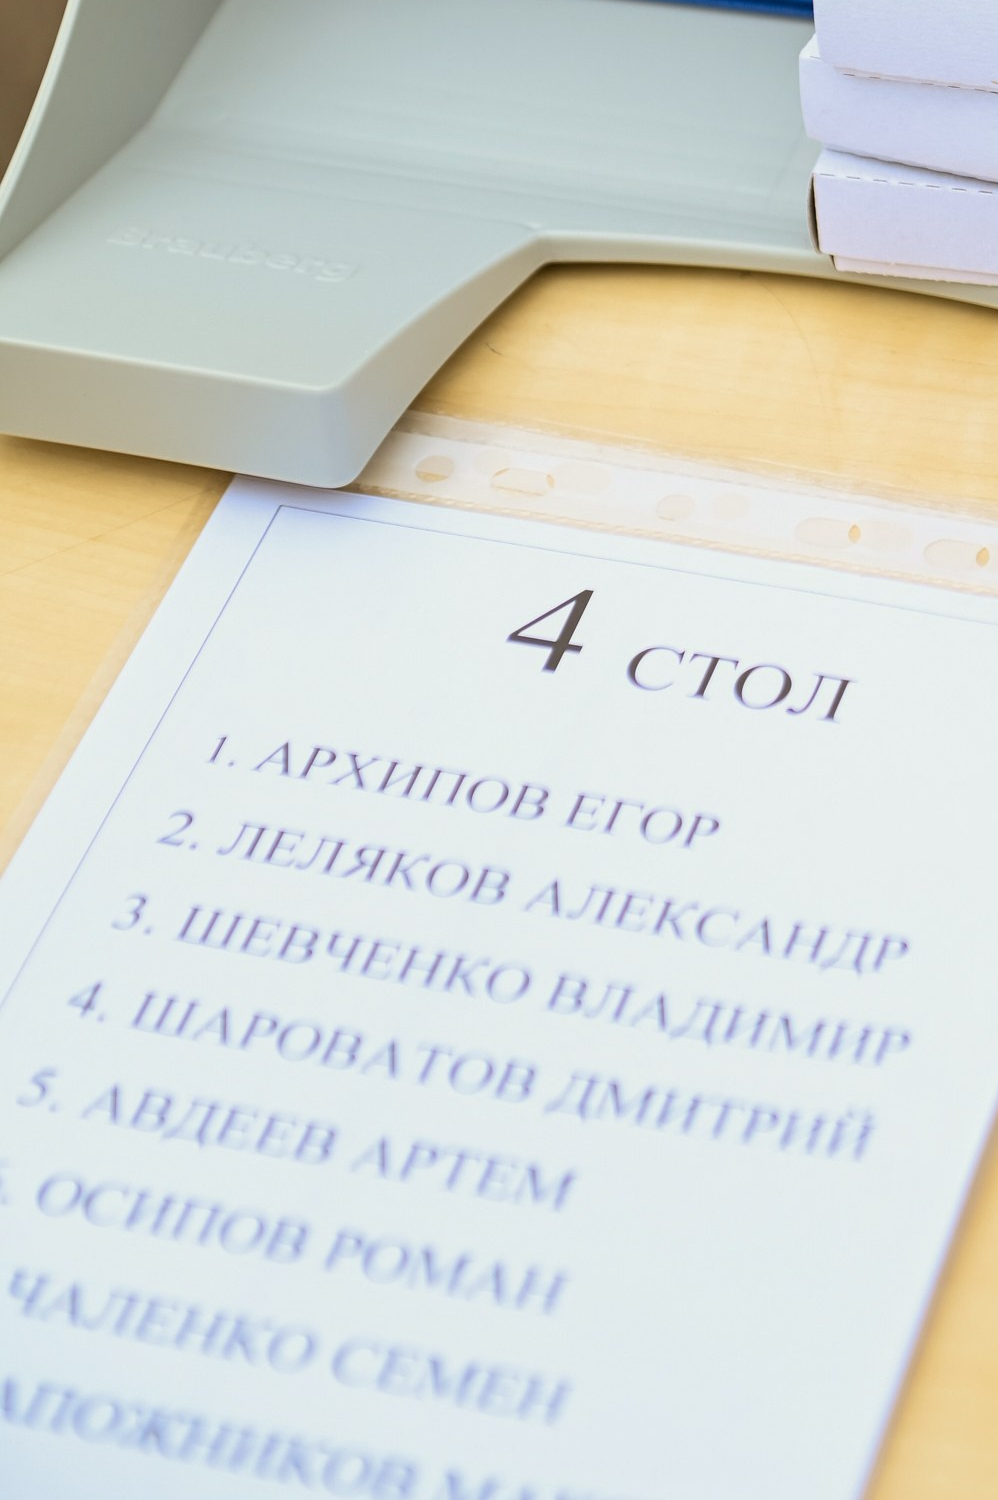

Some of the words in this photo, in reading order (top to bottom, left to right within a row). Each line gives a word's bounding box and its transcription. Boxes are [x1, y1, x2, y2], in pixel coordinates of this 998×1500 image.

[506, 589, 595, 674] 4
[626, 646, 855, 723] СТОЛ
[206, 735, 237, 769] 1.
[251, 739, 551, 824] АРХИПОВ
[564, 792, 722, 850] ЕГОР
[157, 810, 200, 852] 2.
[216, 820, 512, 906] ЛЕЛЯКОВ
[523, 878, 911, 976] АЛЕКСАНДР
[111, 894, 153, 936] 3.
[175, 905, 532, 1007] ШЕВЧЕНКО
[545, 961, 913, 1066] ВЛАДИМИР
[16, 1069, 59, 1112] 5.
[80, 1083, 340, 1164] АВДЕЕВ
[350, 1132, 579, 1213] АРТЕМ
[68, 981, 107, 1022] 4.
[130, 991, 538, 1105] ШАРОВАТОВ
[543, 1069, 877, 1161] ДМИТРИЙ
[34, 1176, 311, 1260] ОСИПОВ
[321, 1228, 570, 1314] РОМАН
[6, 1267, 320, 1376] ЧАЛЕНКО
[328, 1339, 573, 1424] СЕМЕН
